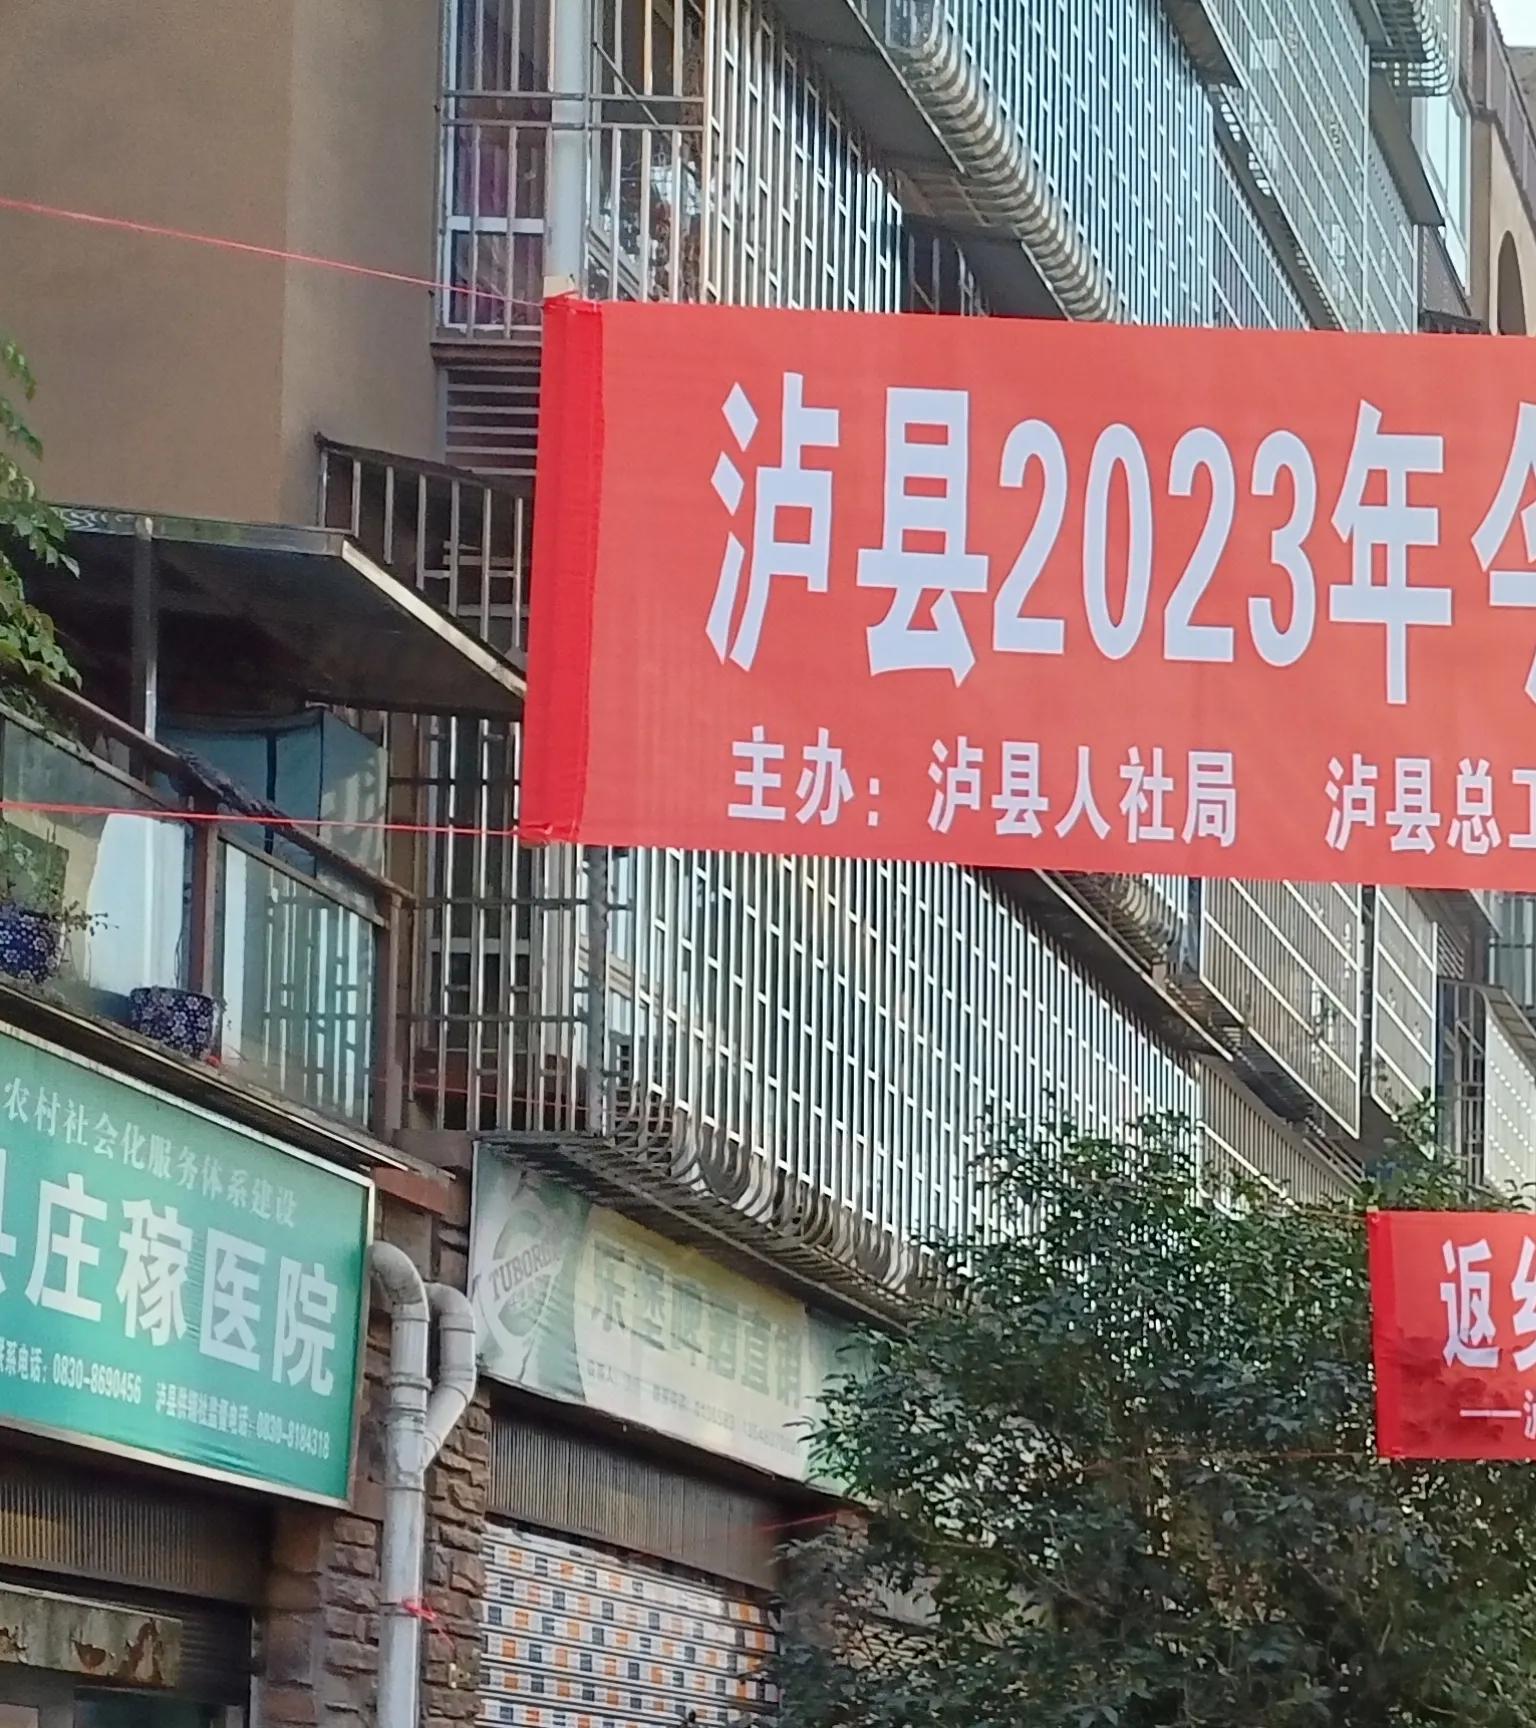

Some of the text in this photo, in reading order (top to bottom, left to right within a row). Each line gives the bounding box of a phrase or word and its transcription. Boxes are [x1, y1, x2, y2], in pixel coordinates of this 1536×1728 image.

[3, 1076, 297, 1230] 农村社会化服务体系建设
[0, 1147, 339, 1398] 庄稼医院
